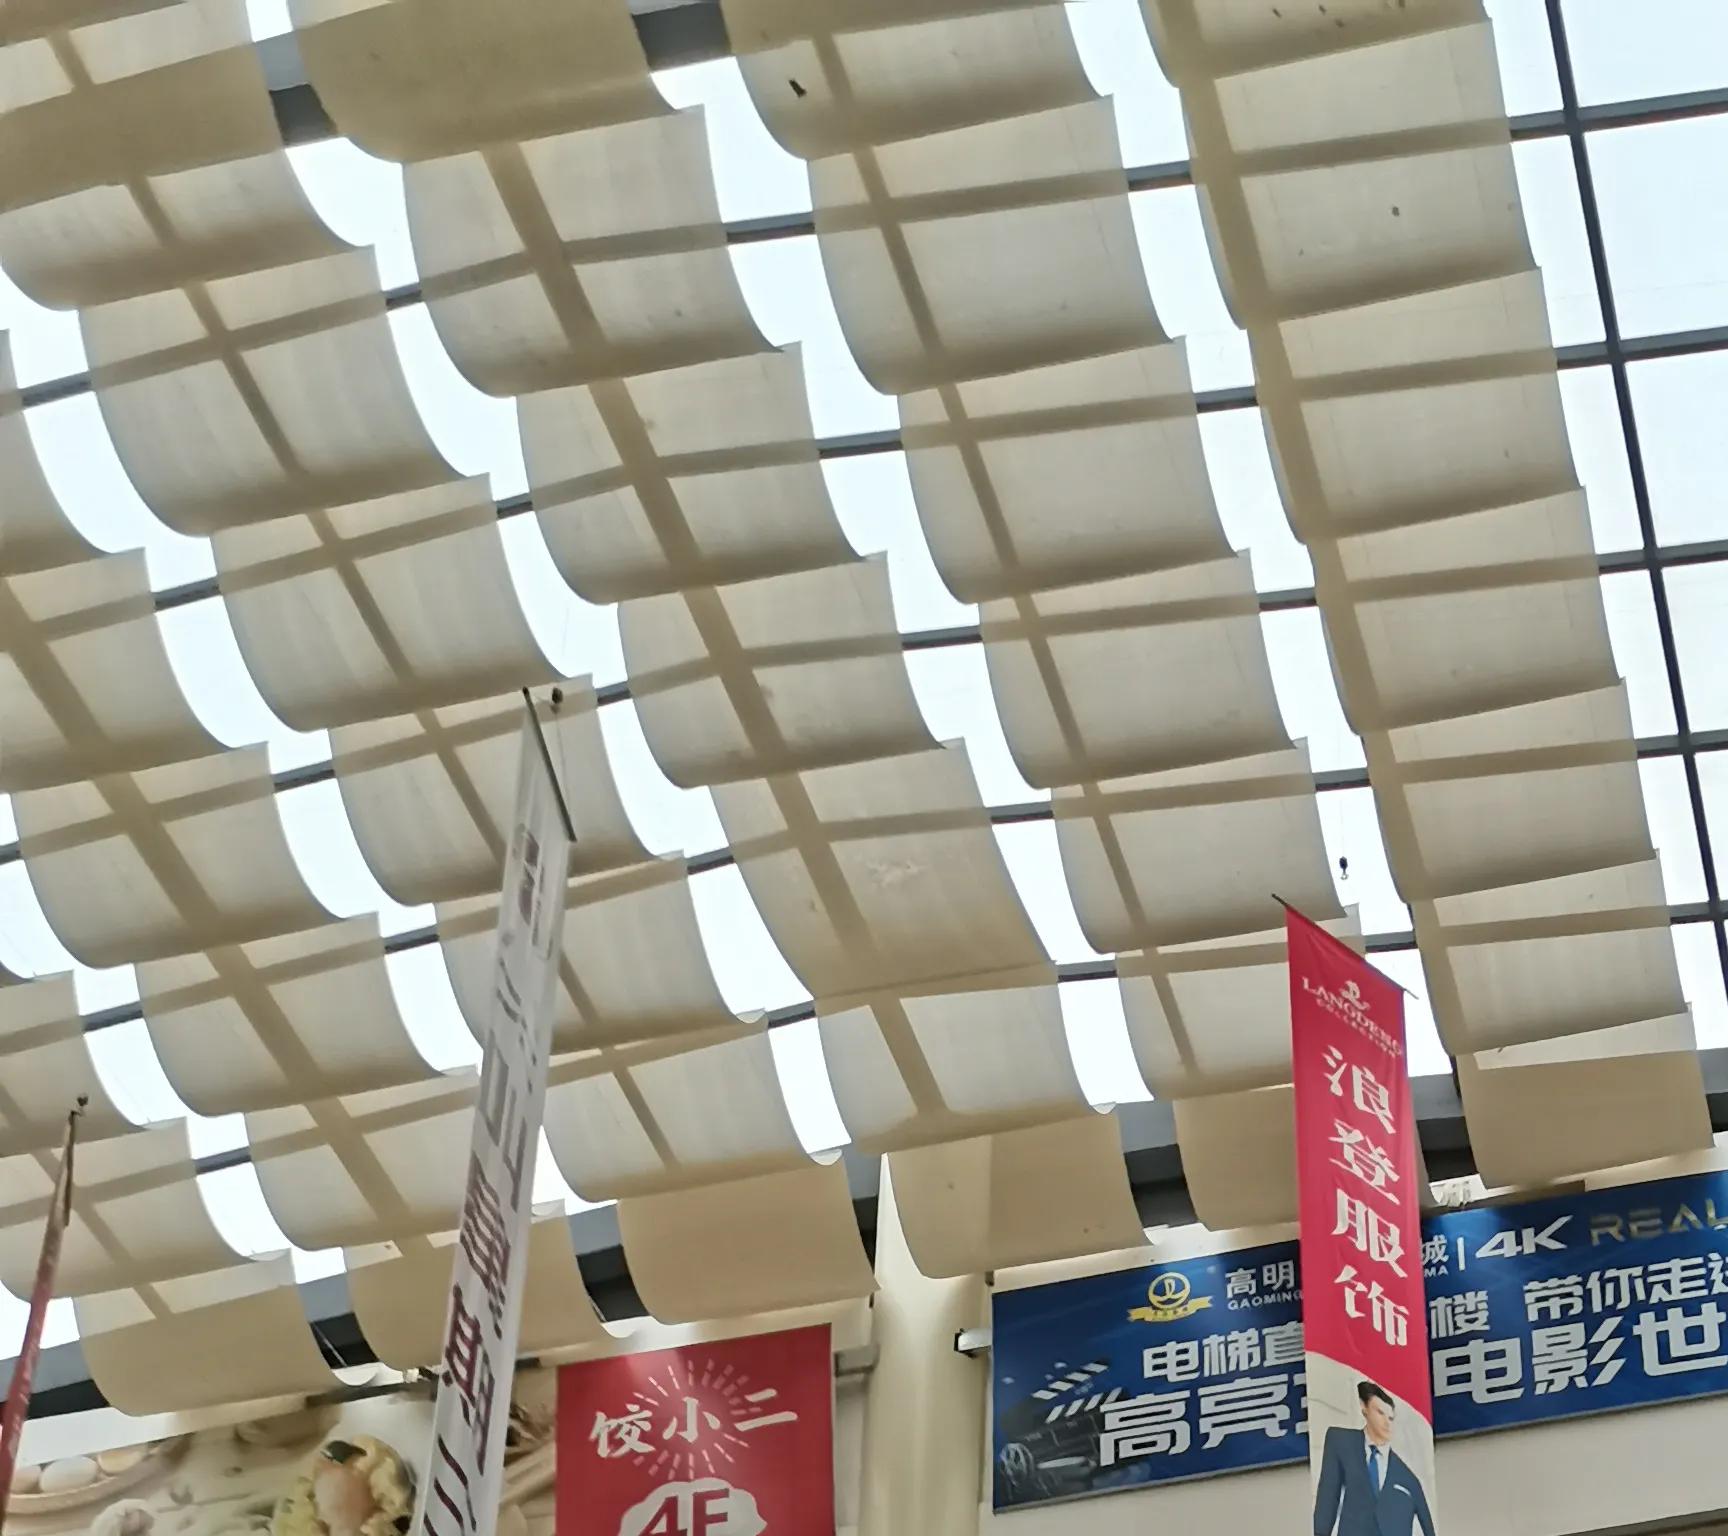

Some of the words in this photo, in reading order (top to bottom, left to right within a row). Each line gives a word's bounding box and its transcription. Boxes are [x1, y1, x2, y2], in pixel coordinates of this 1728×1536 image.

[1320, 1044, 1409, 1346] 浪登服饰
[1225, 1259, 1296, 1299] 高明
[1475, 1214, 1573, 1259] 4K
[1428, 1289, 1491, 1340] 楼
[589, 1388, 798, 1458] 饺小二
[1099, 1371, 1310, 1468] 高亮
